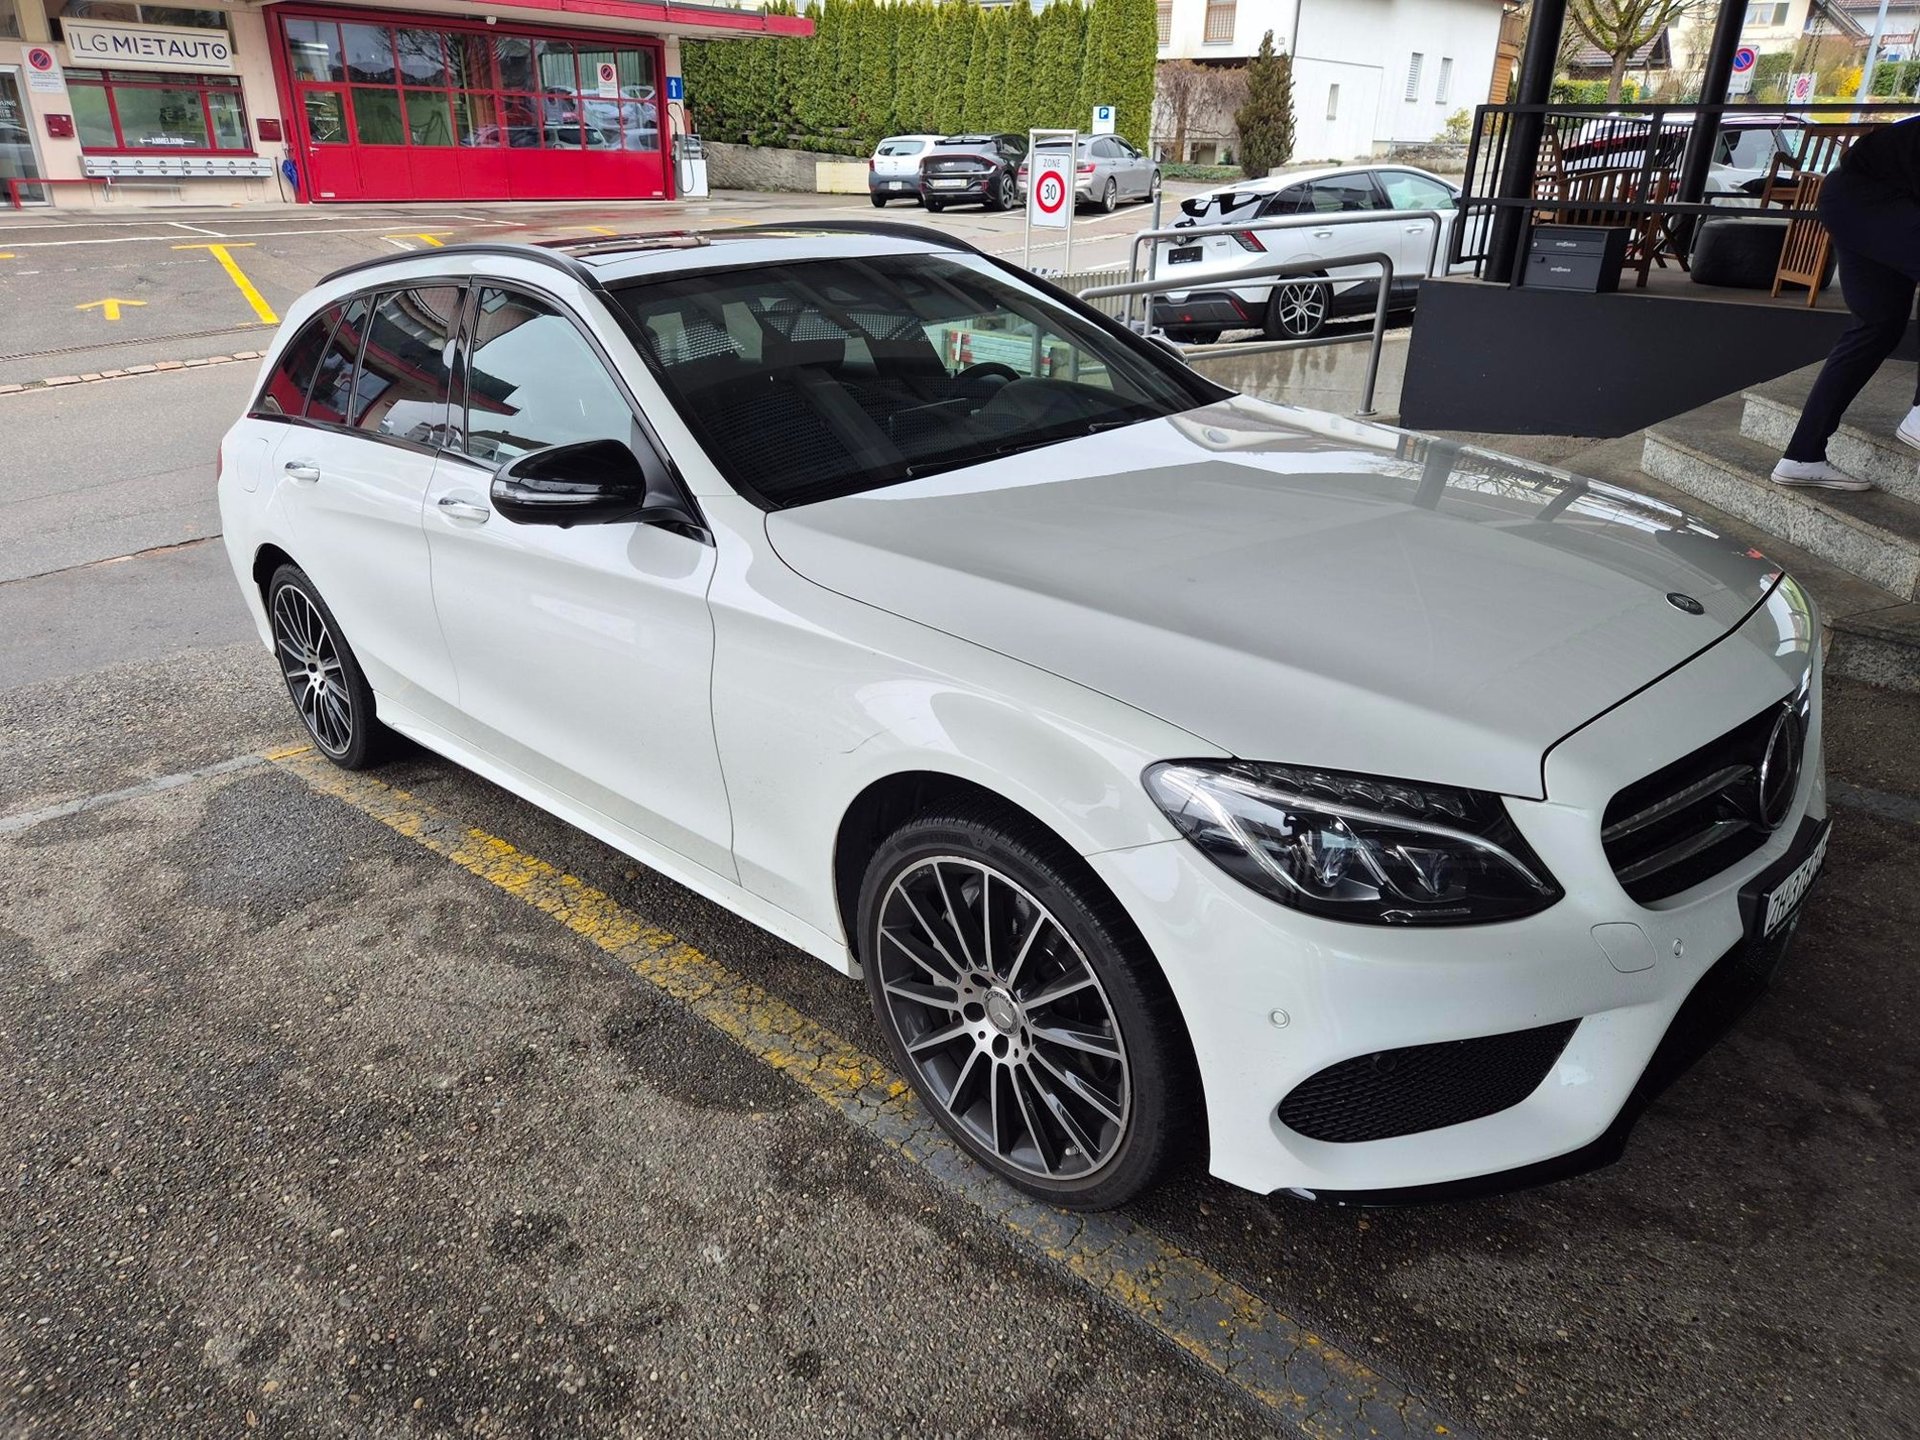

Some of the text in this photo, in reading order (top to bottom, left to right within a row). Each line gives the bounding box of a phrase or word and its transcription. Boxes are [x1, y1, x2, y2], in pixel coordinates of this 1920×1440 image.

[69, 32, 228, 60] ILG MIETAUTO
[1043, 159, 1062, 168] ZONE
[1044, 184, 1057, 200] 30
